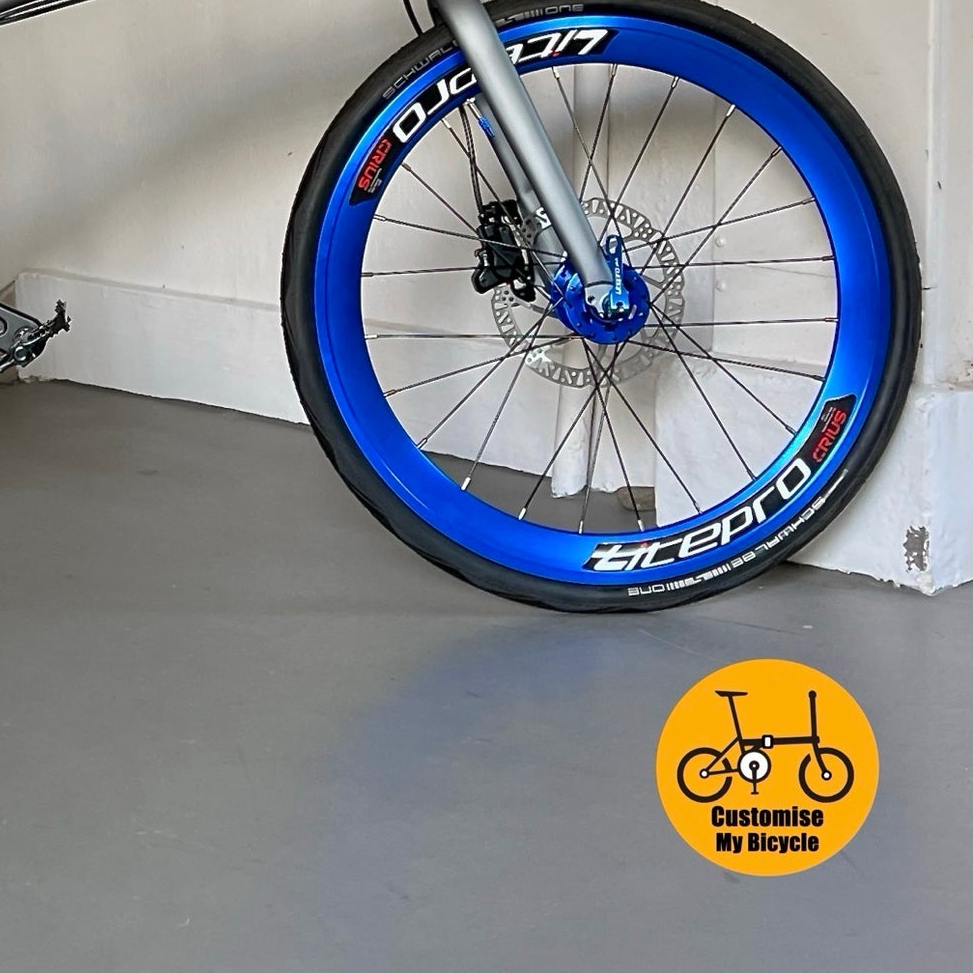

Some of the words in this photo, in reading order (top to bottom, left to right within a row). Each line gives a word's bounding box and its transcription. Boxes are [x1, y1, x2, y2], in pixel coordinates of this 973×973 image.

[382, 39, 458, 100] SCHWAL
[358, 137, 392, 192] CRIUS
[812, 410, 847, 463] CRIUS
[731, 496, 826, 568] SCHWALBE
[627, 583, 665, 596] ONE
